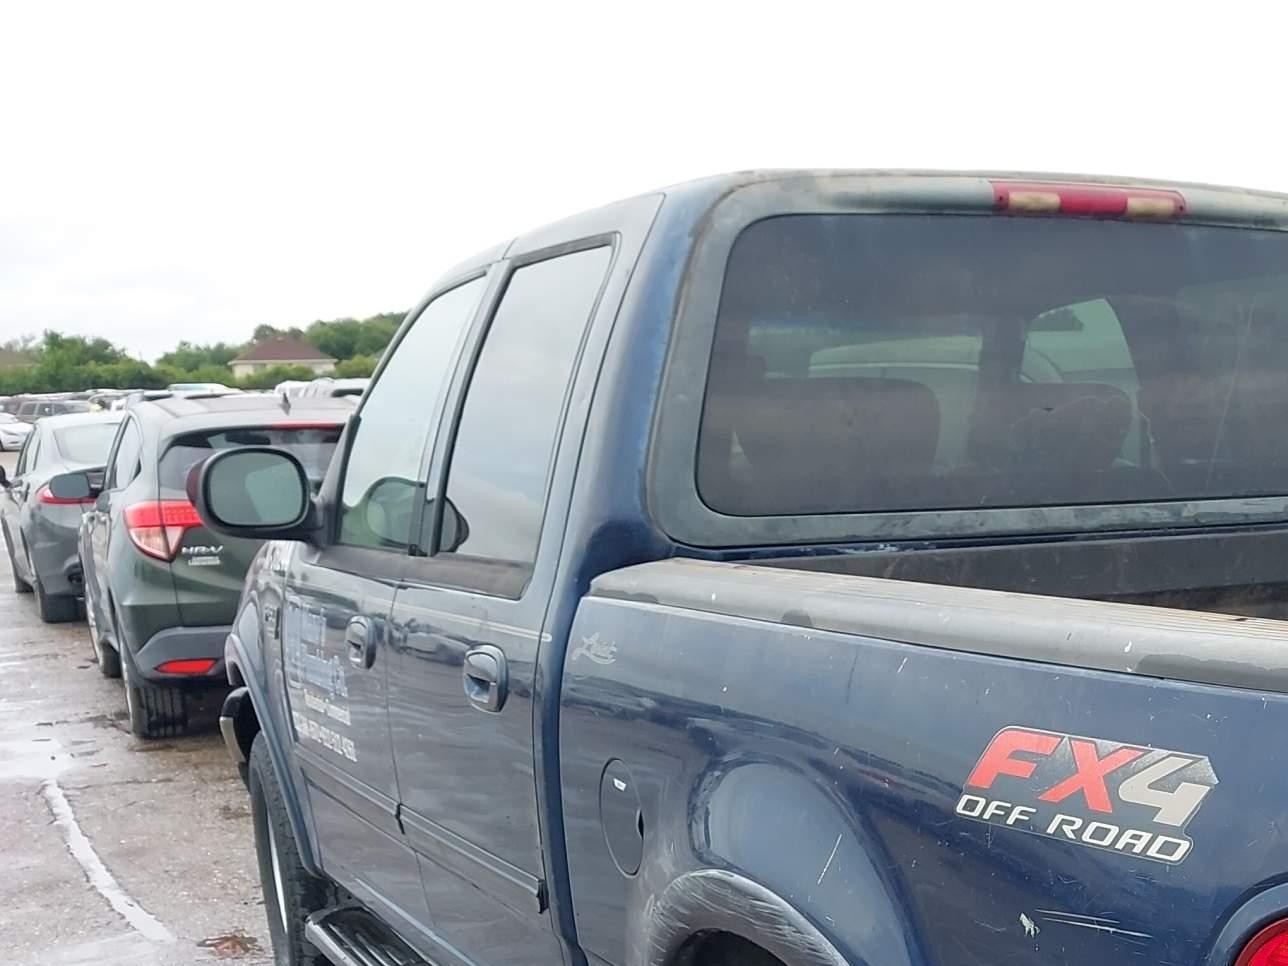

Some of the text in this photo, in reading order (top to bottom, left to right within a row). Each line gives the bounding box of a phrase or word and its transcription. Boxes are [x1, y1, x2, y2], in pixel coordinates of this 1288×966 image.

[966, 729, 1213, 828] FX4
[955, 793, 1192, 863] OFF ROAD
